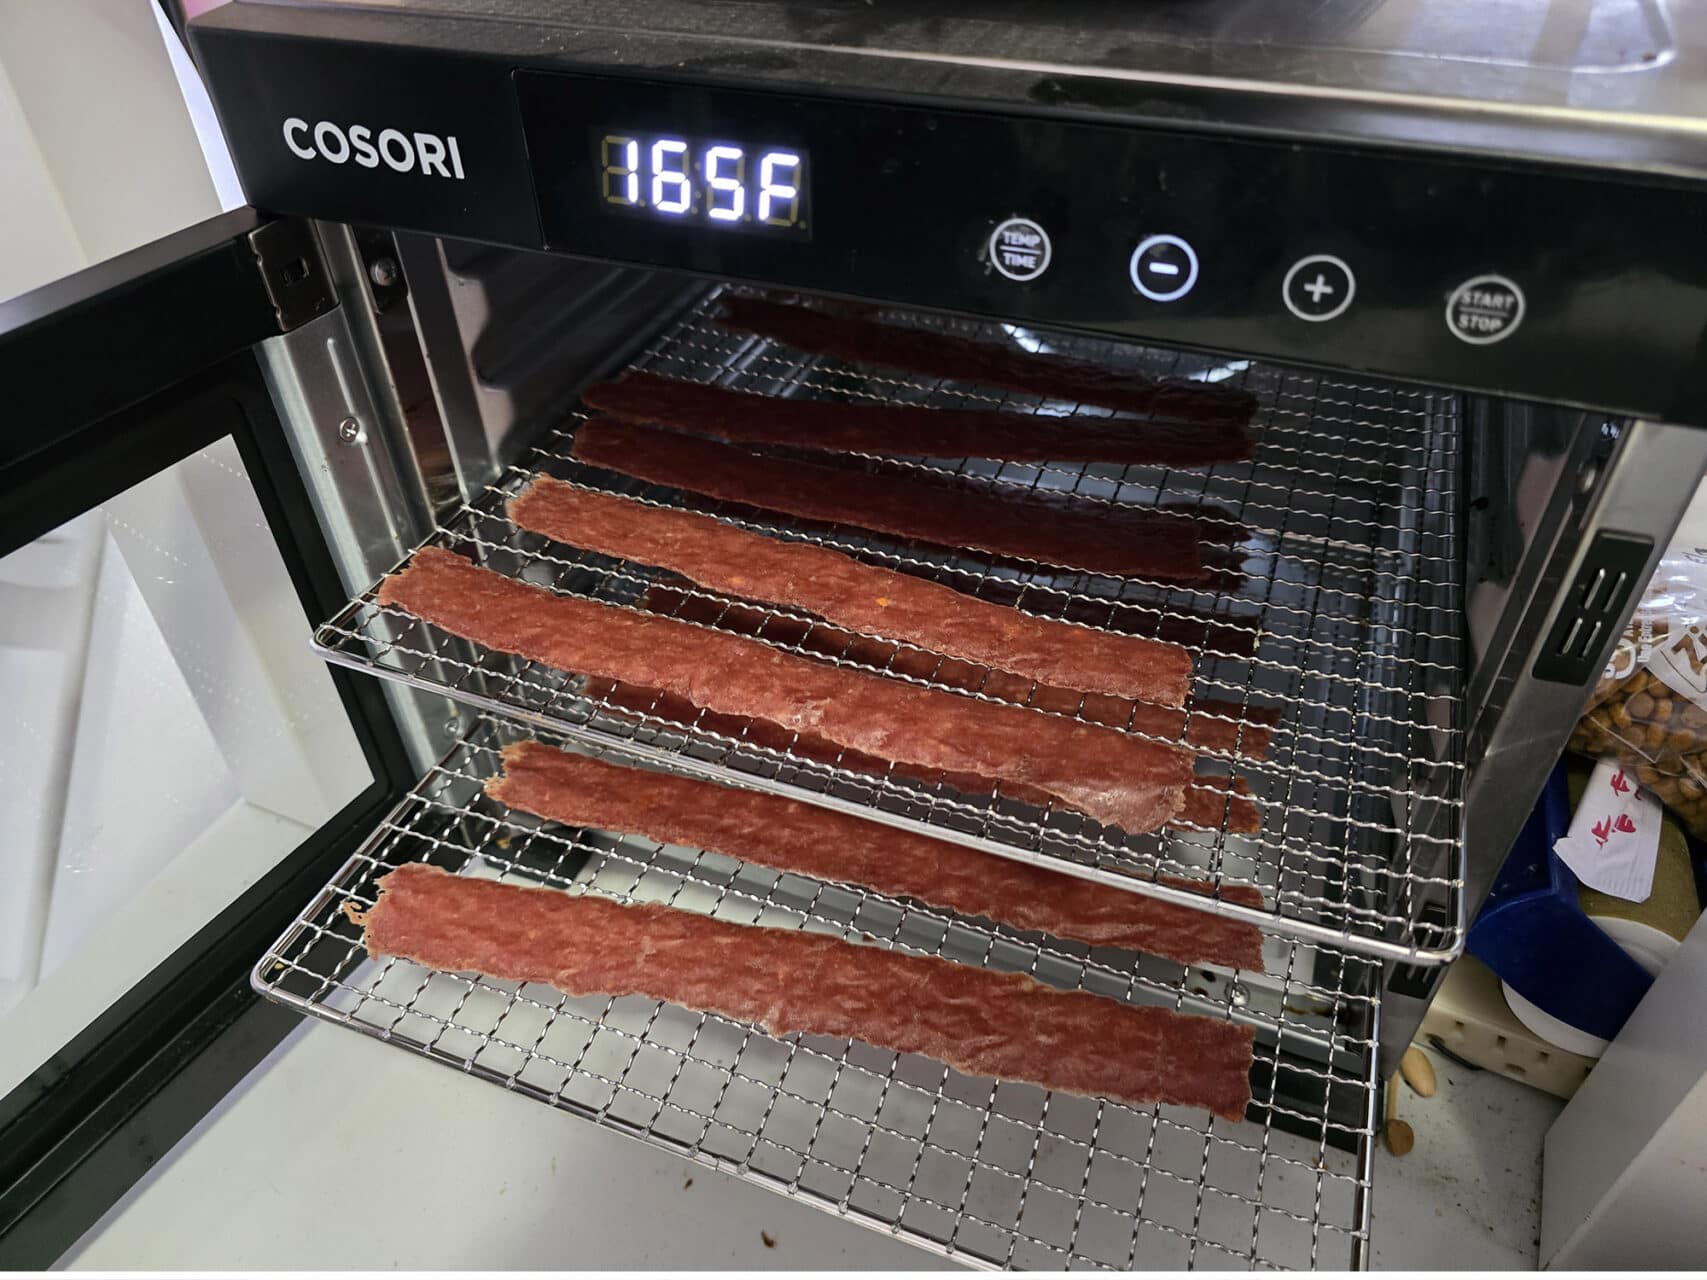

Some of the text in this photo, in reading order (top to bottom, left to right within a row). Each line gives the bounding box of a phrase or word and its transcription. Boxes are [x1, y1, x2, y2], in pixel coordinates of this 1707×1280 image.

[283, 117, 465, 180] COSORI
[627, 139, 800, 222] 165F
[1002, 230, 1042, 247] TEMP
[1003, 252, 1037, 269] TIME
[1461, 290, 1515, 309] START
[1458, 314, 1502, 332] STOP
